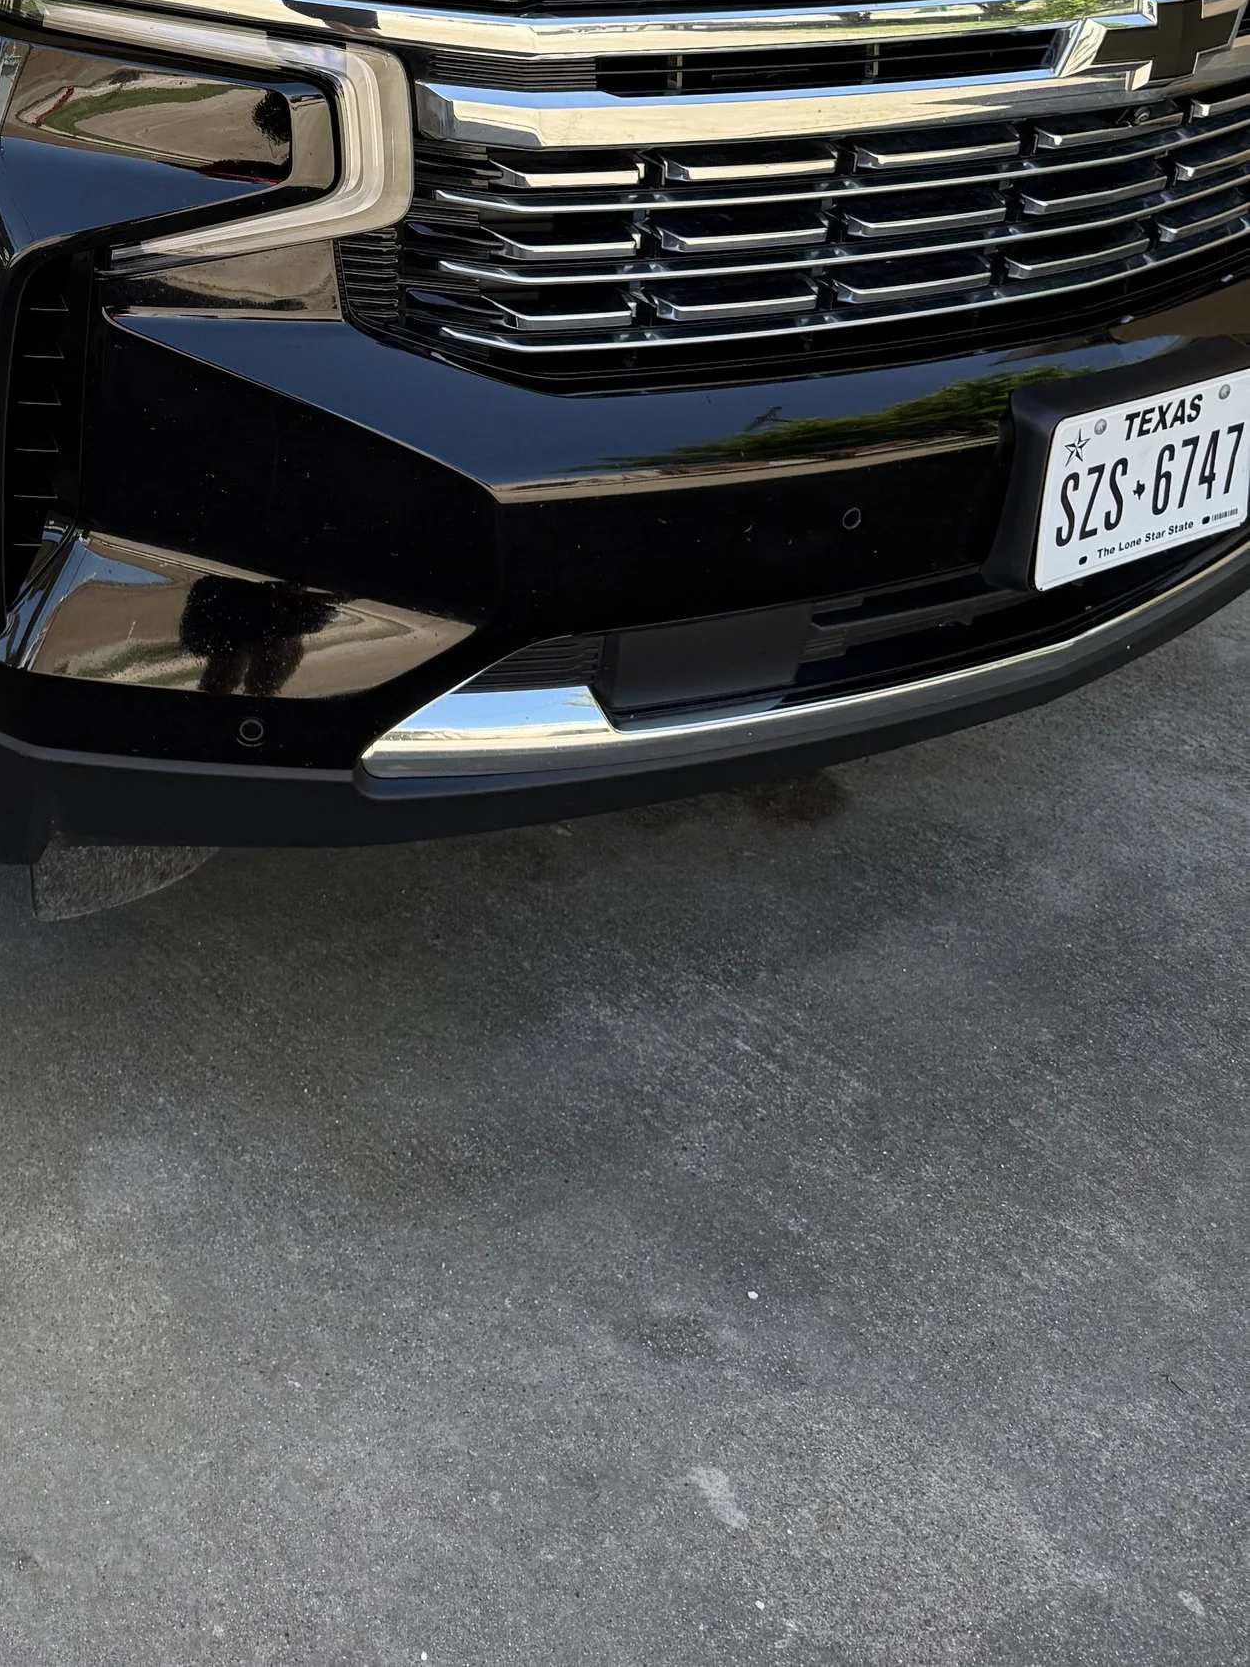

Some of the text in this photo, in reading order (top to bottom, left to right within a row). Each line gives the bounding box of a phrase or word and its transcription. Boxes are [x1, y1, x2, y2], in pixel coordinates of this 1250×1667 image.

[1124, 394, 1204, 441] TEXAS
[1055, 422, 1245, 547] SZS 6747
[1097, 520, 1194, 559] The Lone Star State
